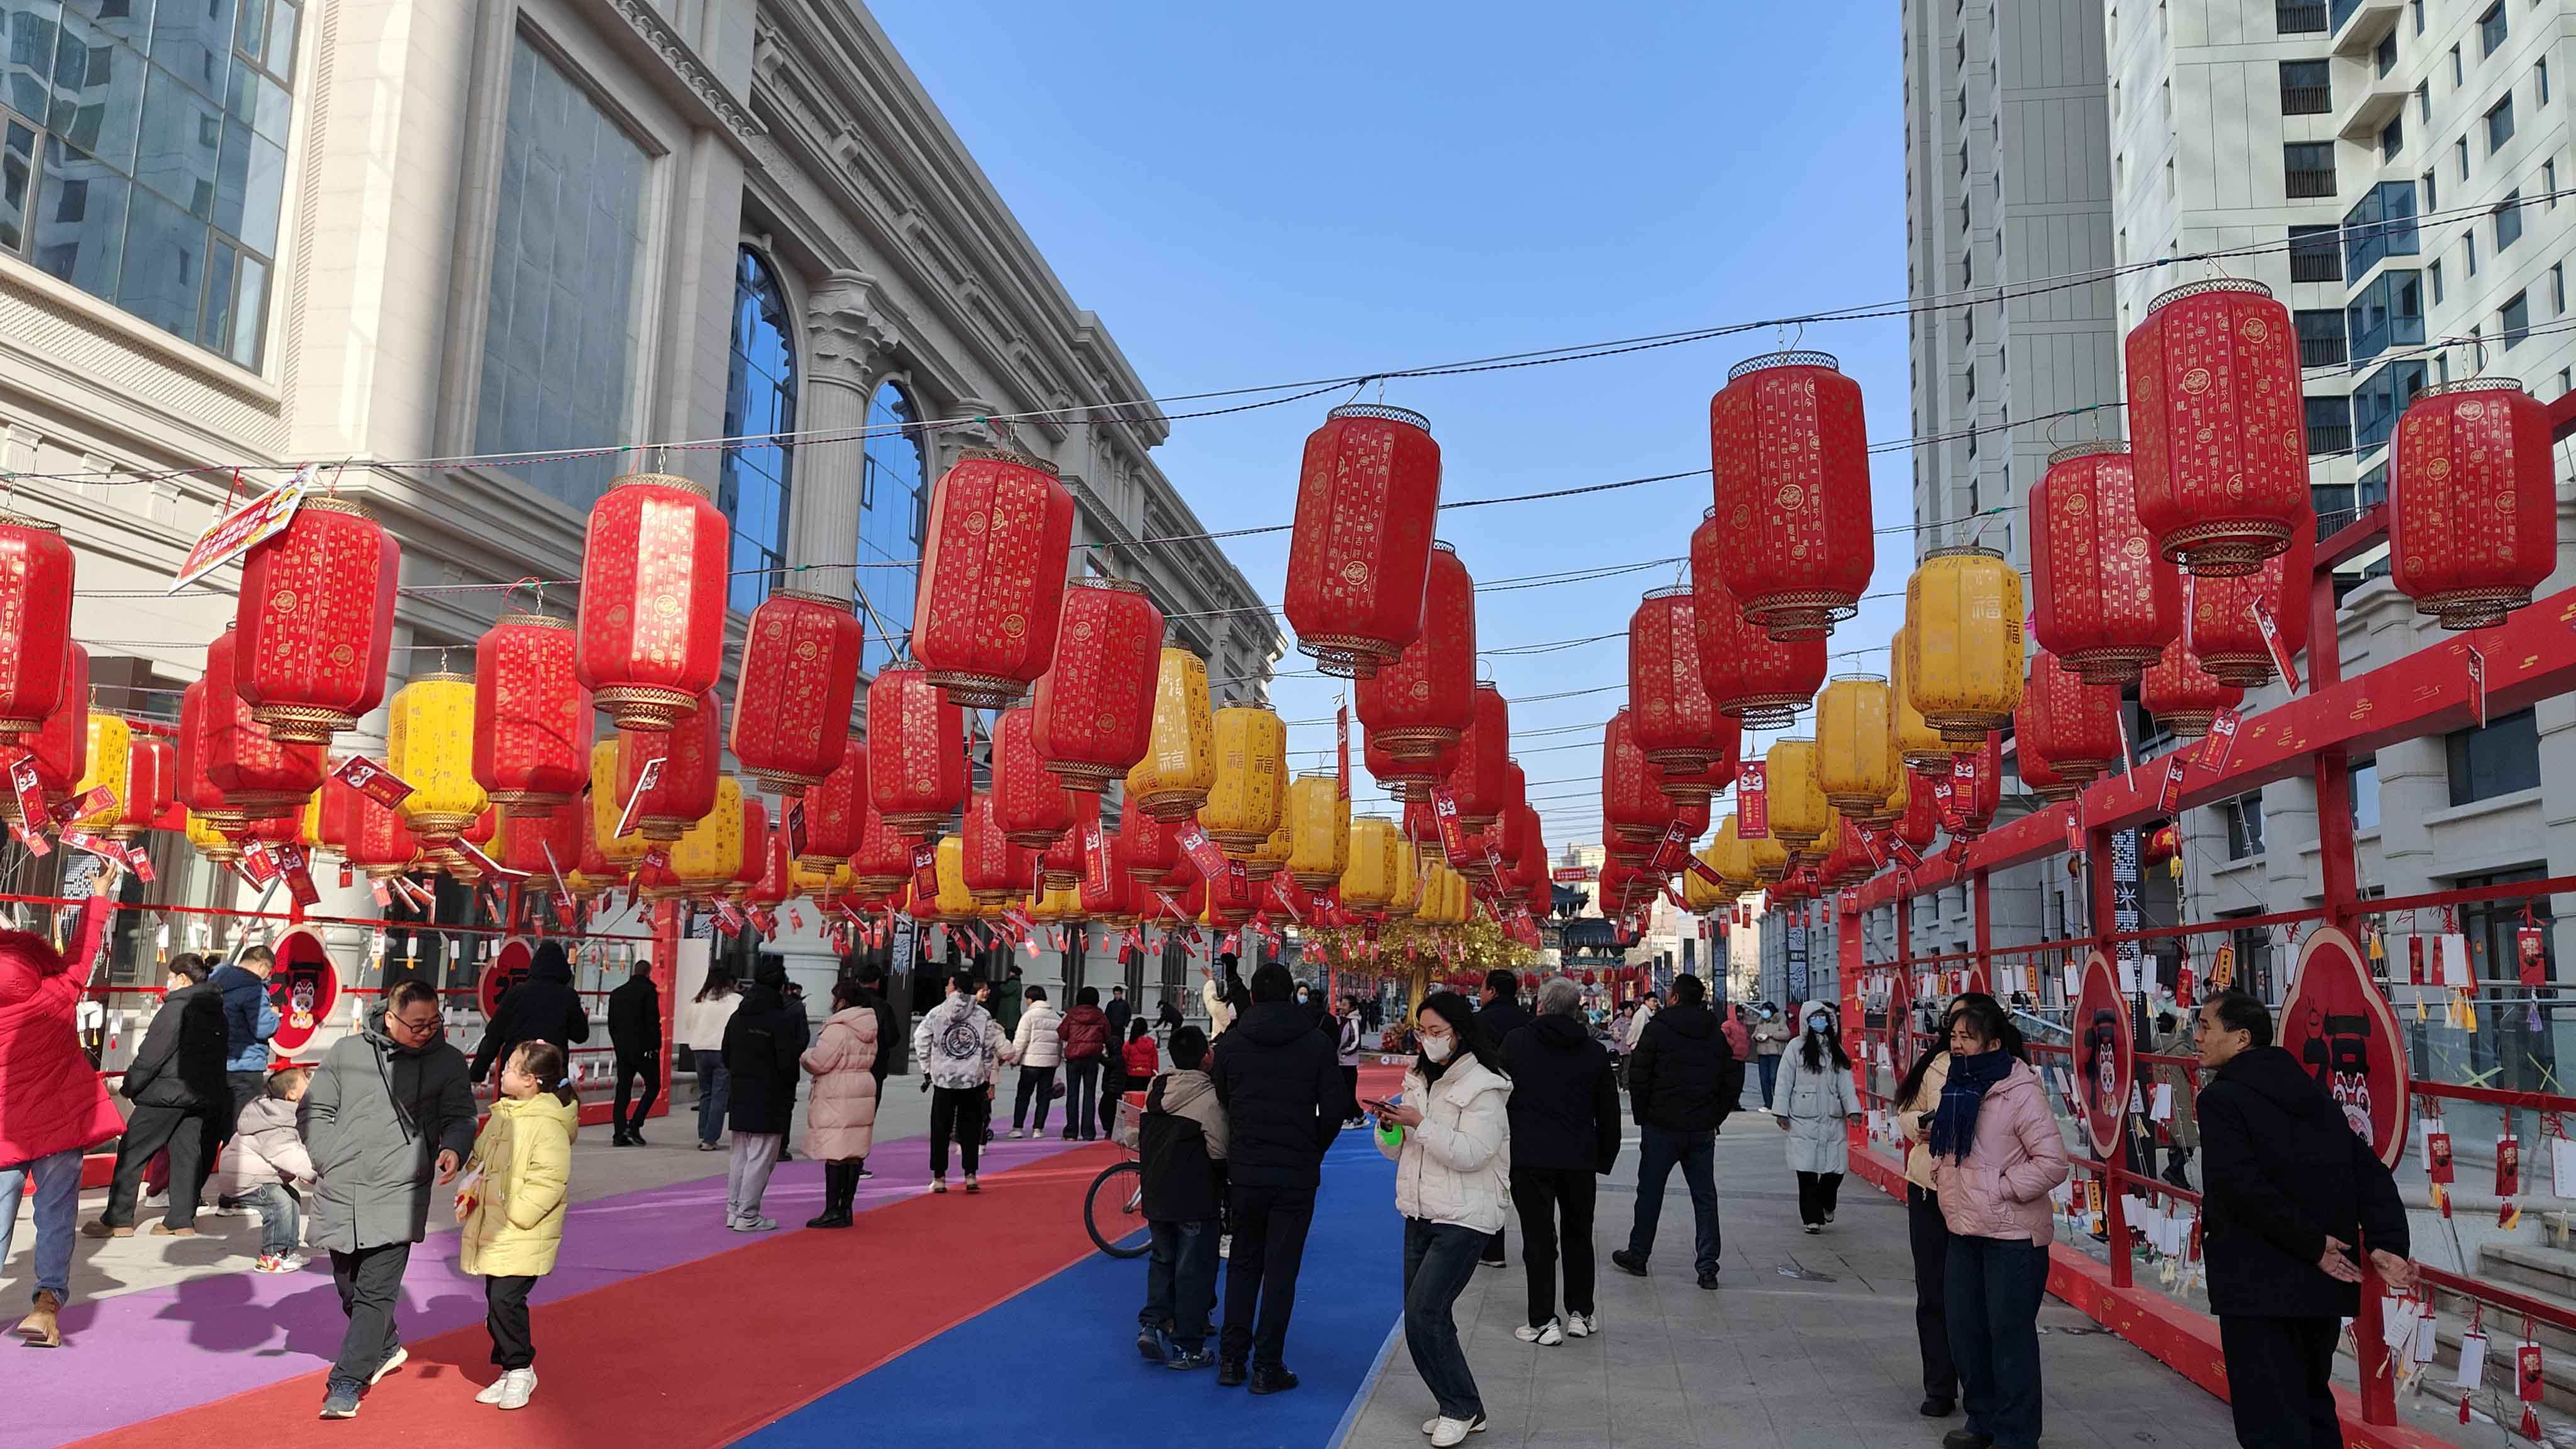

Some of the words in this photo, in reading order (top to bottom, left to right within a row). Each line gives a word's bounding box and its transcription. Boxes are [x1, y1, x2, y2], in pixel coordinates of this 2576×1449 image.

[1972, 593, 2002, 619] 福
[2006, 618, 2021, 645] 福
[1158, 750, 1186, 774] 福
[1227, 749, 1244, 770] 福
[1255, 754, 1274, 775] 福
